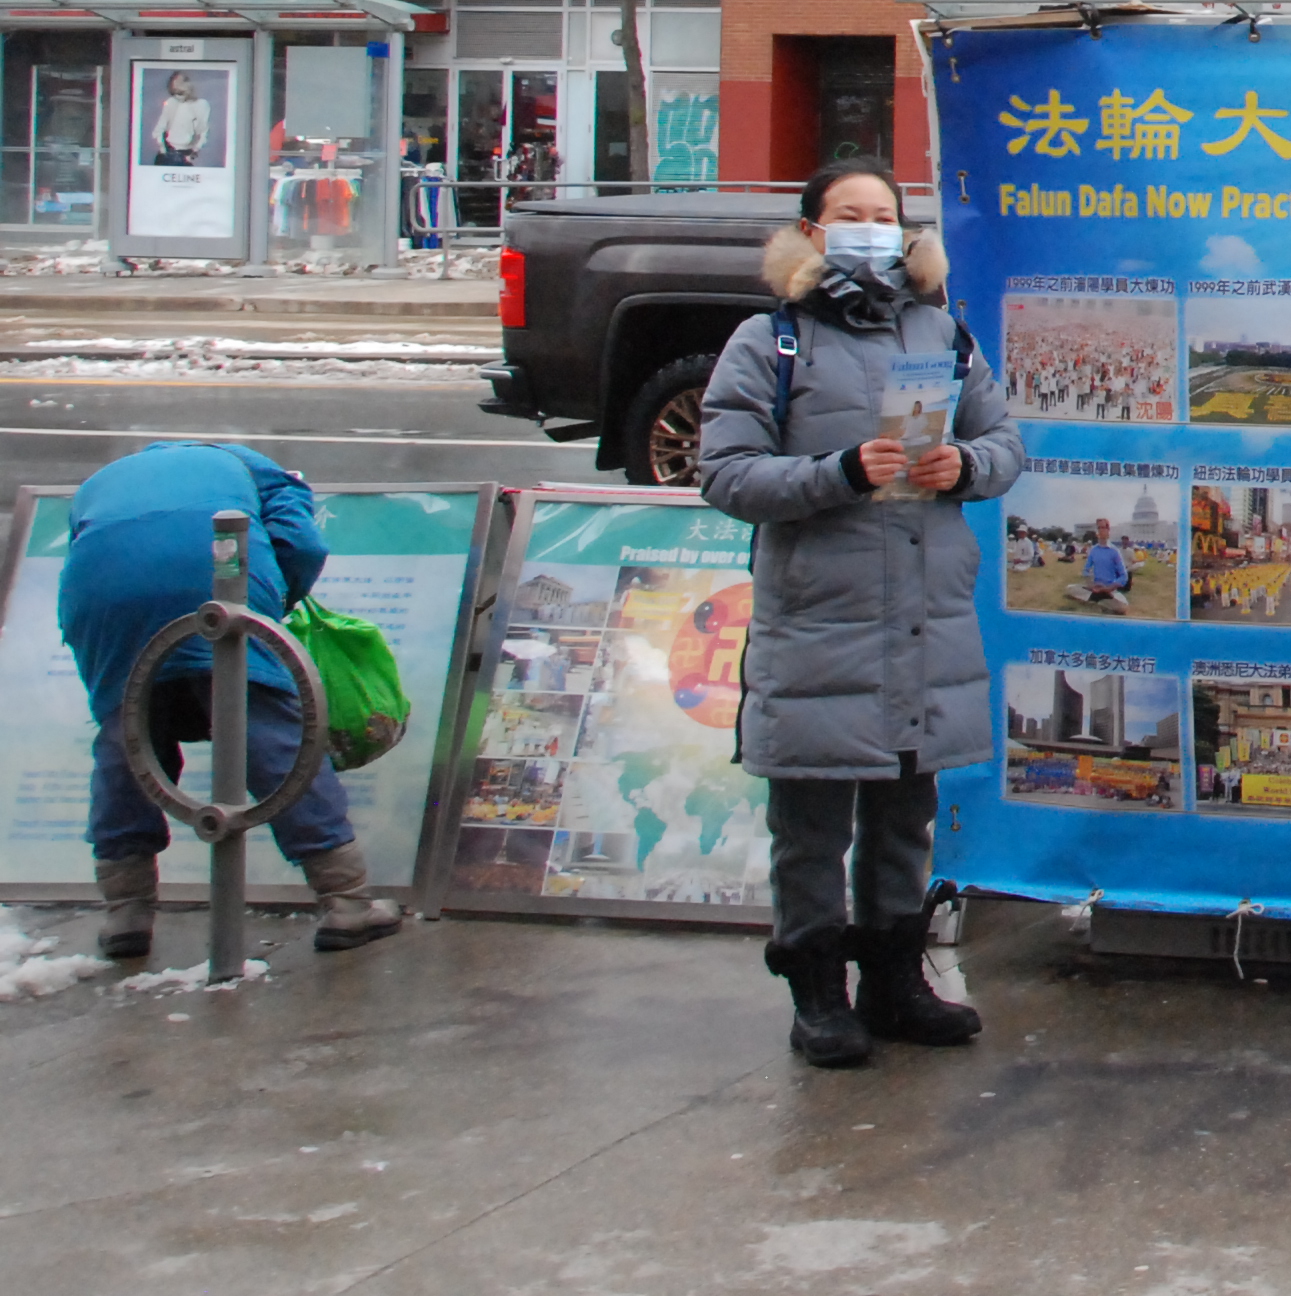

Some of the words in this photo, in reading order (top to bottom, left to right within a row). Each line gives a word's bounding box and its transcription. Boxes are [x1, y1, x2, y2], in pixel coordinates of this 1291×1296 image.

[169, 42, 195, 54] astral
[161, 172, 202, 184] CELINE
[999, 182, 1072, 217] Falun
[1078, 182, 1139, 218] Dafa
[1146, 184, 1212, 218] Now
[619, 545, 679, 563] Praised
[679, 548, 700, 564] by
[701, 551, 736, 564] over
